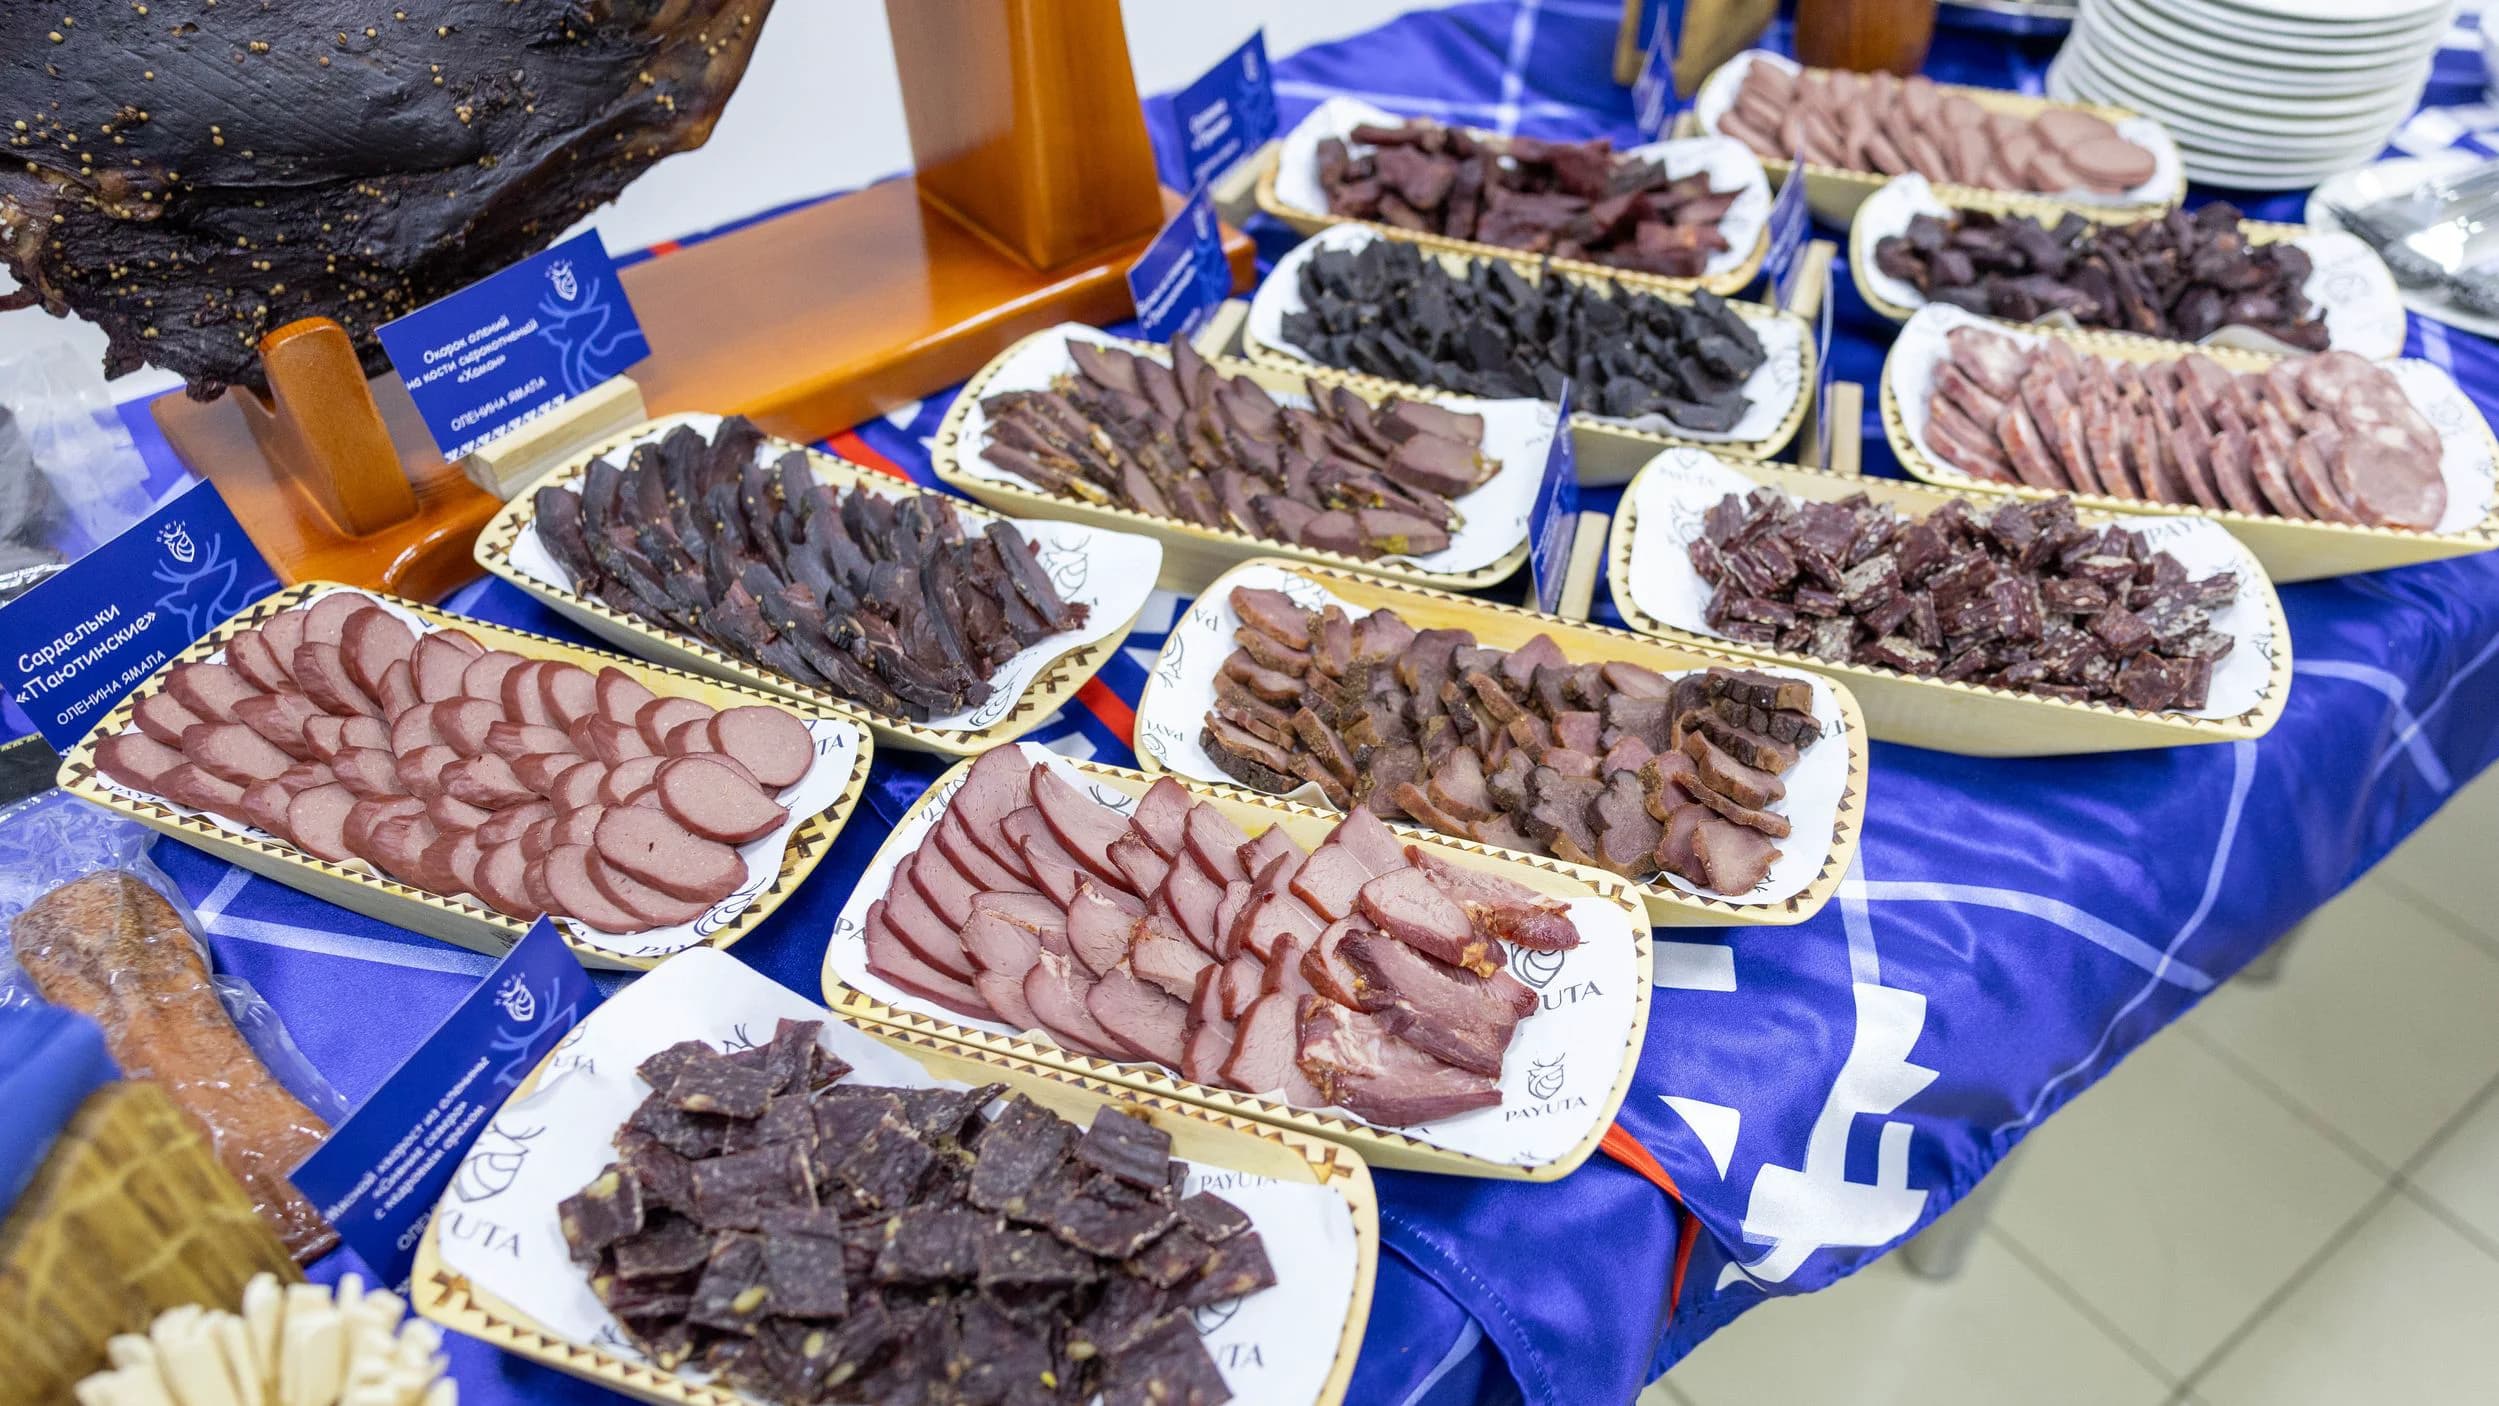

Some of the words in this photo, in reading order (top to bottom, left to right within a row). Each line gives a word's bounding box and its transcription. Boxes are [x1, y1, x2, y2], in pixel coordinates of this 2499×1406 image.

[423, 337, 467, 365] Окорок
[467, 314, 510, 344] олений
[407, 376, 422, 391] на
[423, 359, 457, 384] кости
[451, 397, 508, 432] ОЛЕНИНА
[507, 376, 548, 404] ЯМАЛА
[15, 611, 156, 704] «Паютинские»
[18, 603, 121, 674] Сардельки
[56, 680, 122, 726] ОЛЕНИНА
[122, 650, 166, 685] ЯМАЛА
[1541, 980, 1604, 1011] UTA
[554, 1054, 596, 1075] UTA
[1505, 1096, 1589, 1122] PAYUTA
